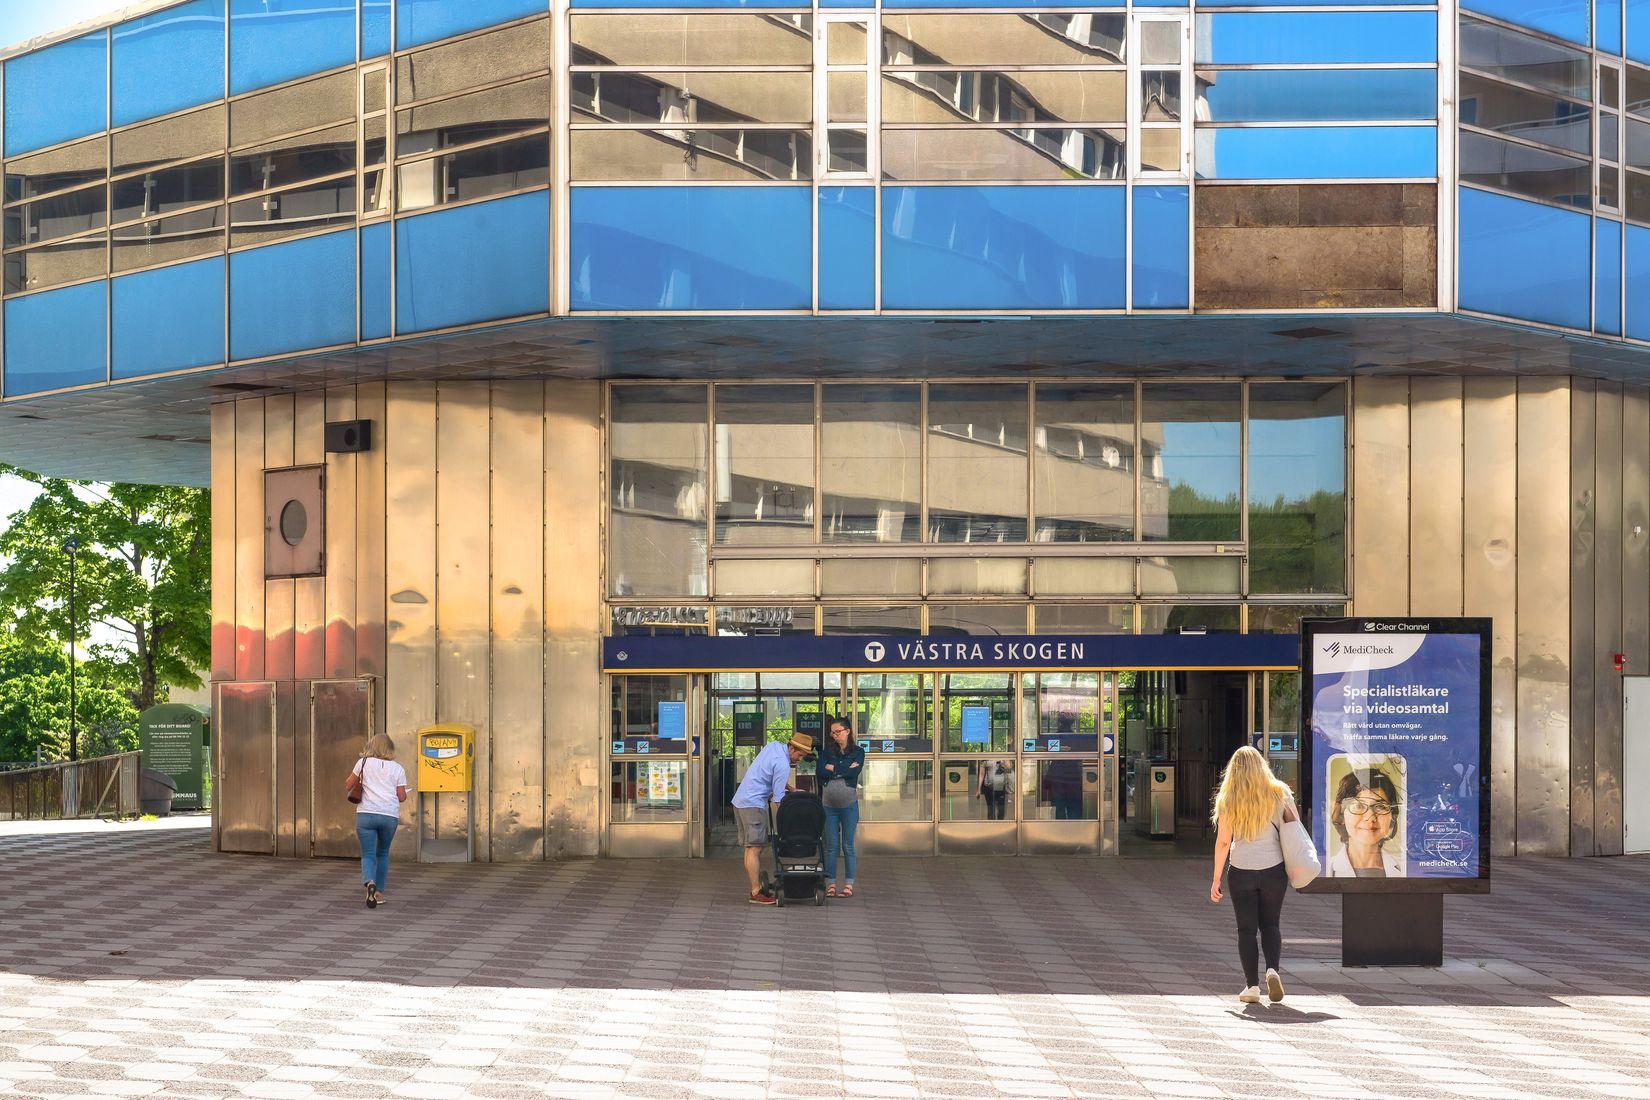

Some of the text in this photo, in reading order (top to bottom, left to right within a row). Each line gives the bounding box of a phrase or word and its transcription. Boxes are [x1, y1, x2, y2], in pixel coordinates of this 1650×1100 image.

[1376, 623, 1430, 631] Clear Channel
[898, 640, 984, 660] VÄSTRA
[993, 642, 1084, 660] SKOGEN
[1343, 645, 1394, 655] MediCheck
[1343, 685, 1449, 700] Specialistläkare
[1343, 702, 1449, 714] via videosamtal
[1411, 734, 1428, 742] varje
[1429, 733, 1449, 742] gång.
